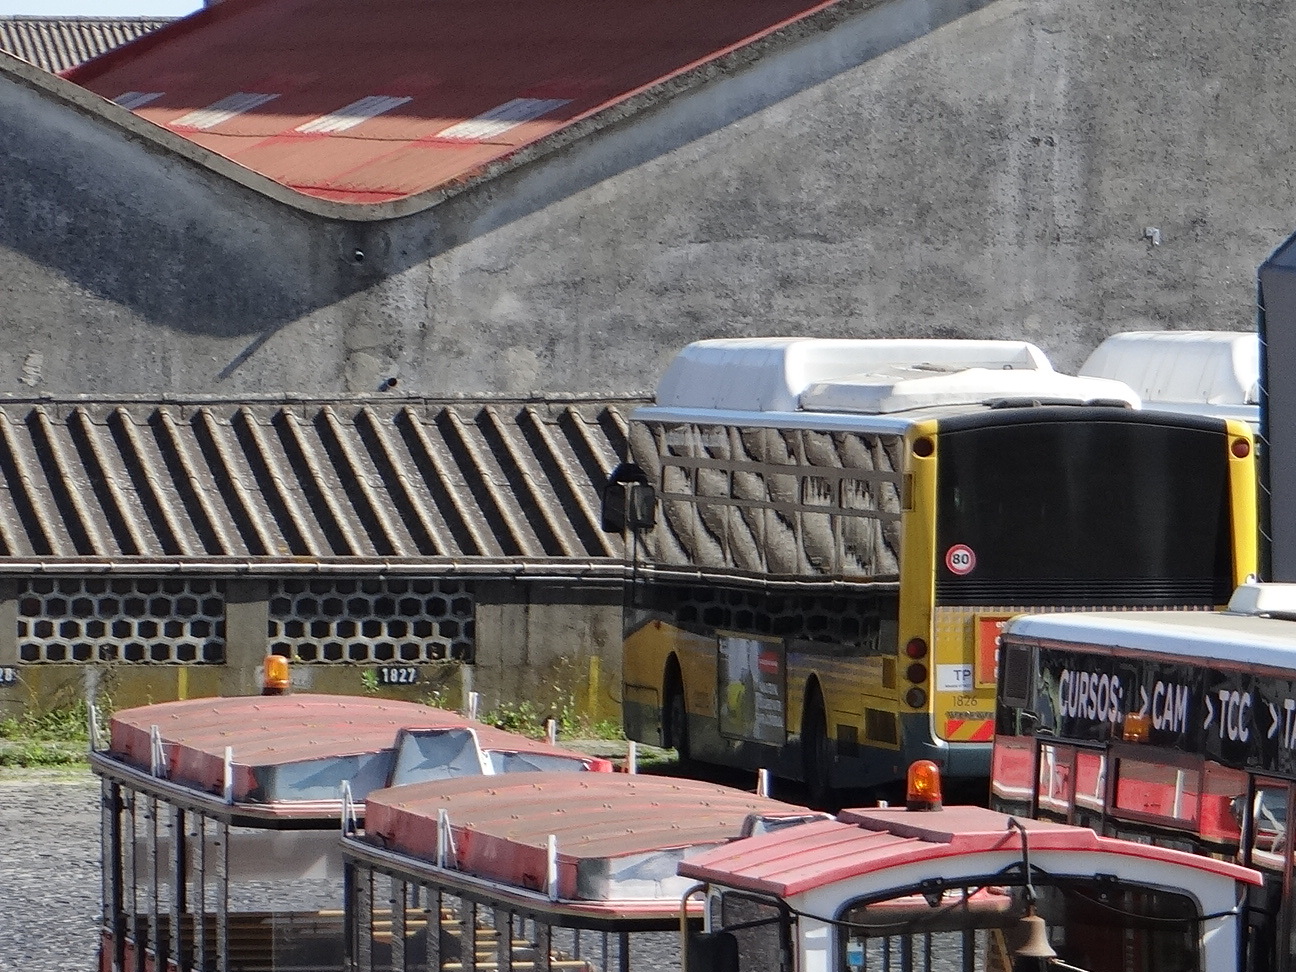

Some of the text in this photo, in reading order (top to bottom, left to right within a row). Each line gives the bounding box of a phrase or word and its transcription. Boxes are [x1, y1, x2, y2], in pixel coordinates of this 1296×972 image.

[952, 553, 969, 565] 80
[382, 667, 417, 683] 1827
[953, 669, 972, 682] TP
[952, 695, 978, 707] 1826
[1058, 668, 1123, 723] CURSOS:
